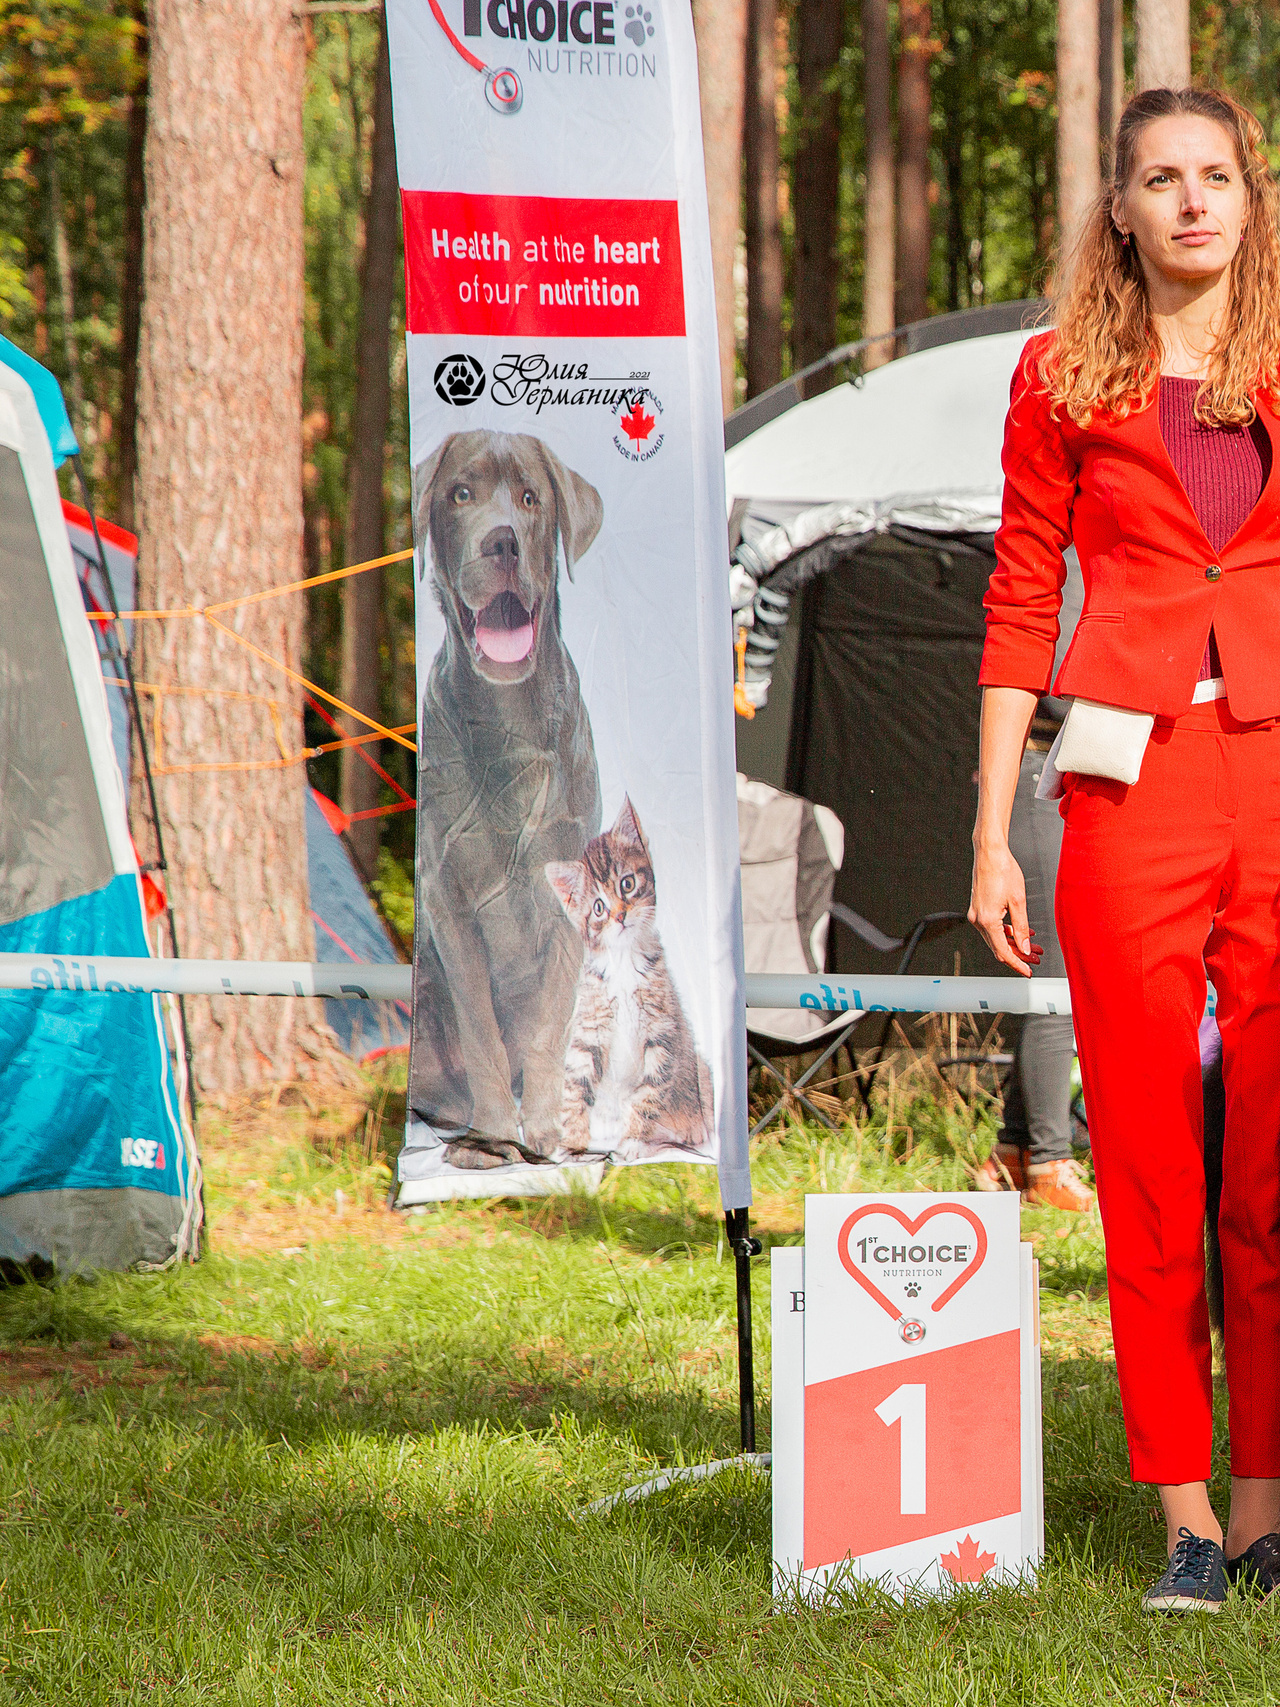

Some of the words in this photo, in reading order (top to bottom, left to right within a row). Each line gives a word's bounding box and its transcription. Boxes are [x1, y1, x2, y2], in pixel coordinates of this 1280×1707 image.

[486, 0, 616, 45] CHOICE
[527, 48, 656, 78] NUTRITION
[431, 228, 510, 261] Health
[523, 235, 549, 263] at
[554, 234, 585, 264] the
[594, 234, 661, 264] heart
[458, 274, 479, 303] of
[539, 277, 640, 306] nutrition
[612, 435, 631, 460] MADE
[631, 453, 639, 462] IN
[640, 433, 665, 462] CANADA
[873, 1245, 968, 1263] CHOICE
[883, 1269, 942, 1277] NUTRITION
[874, 1383, 926, 1515] 1
